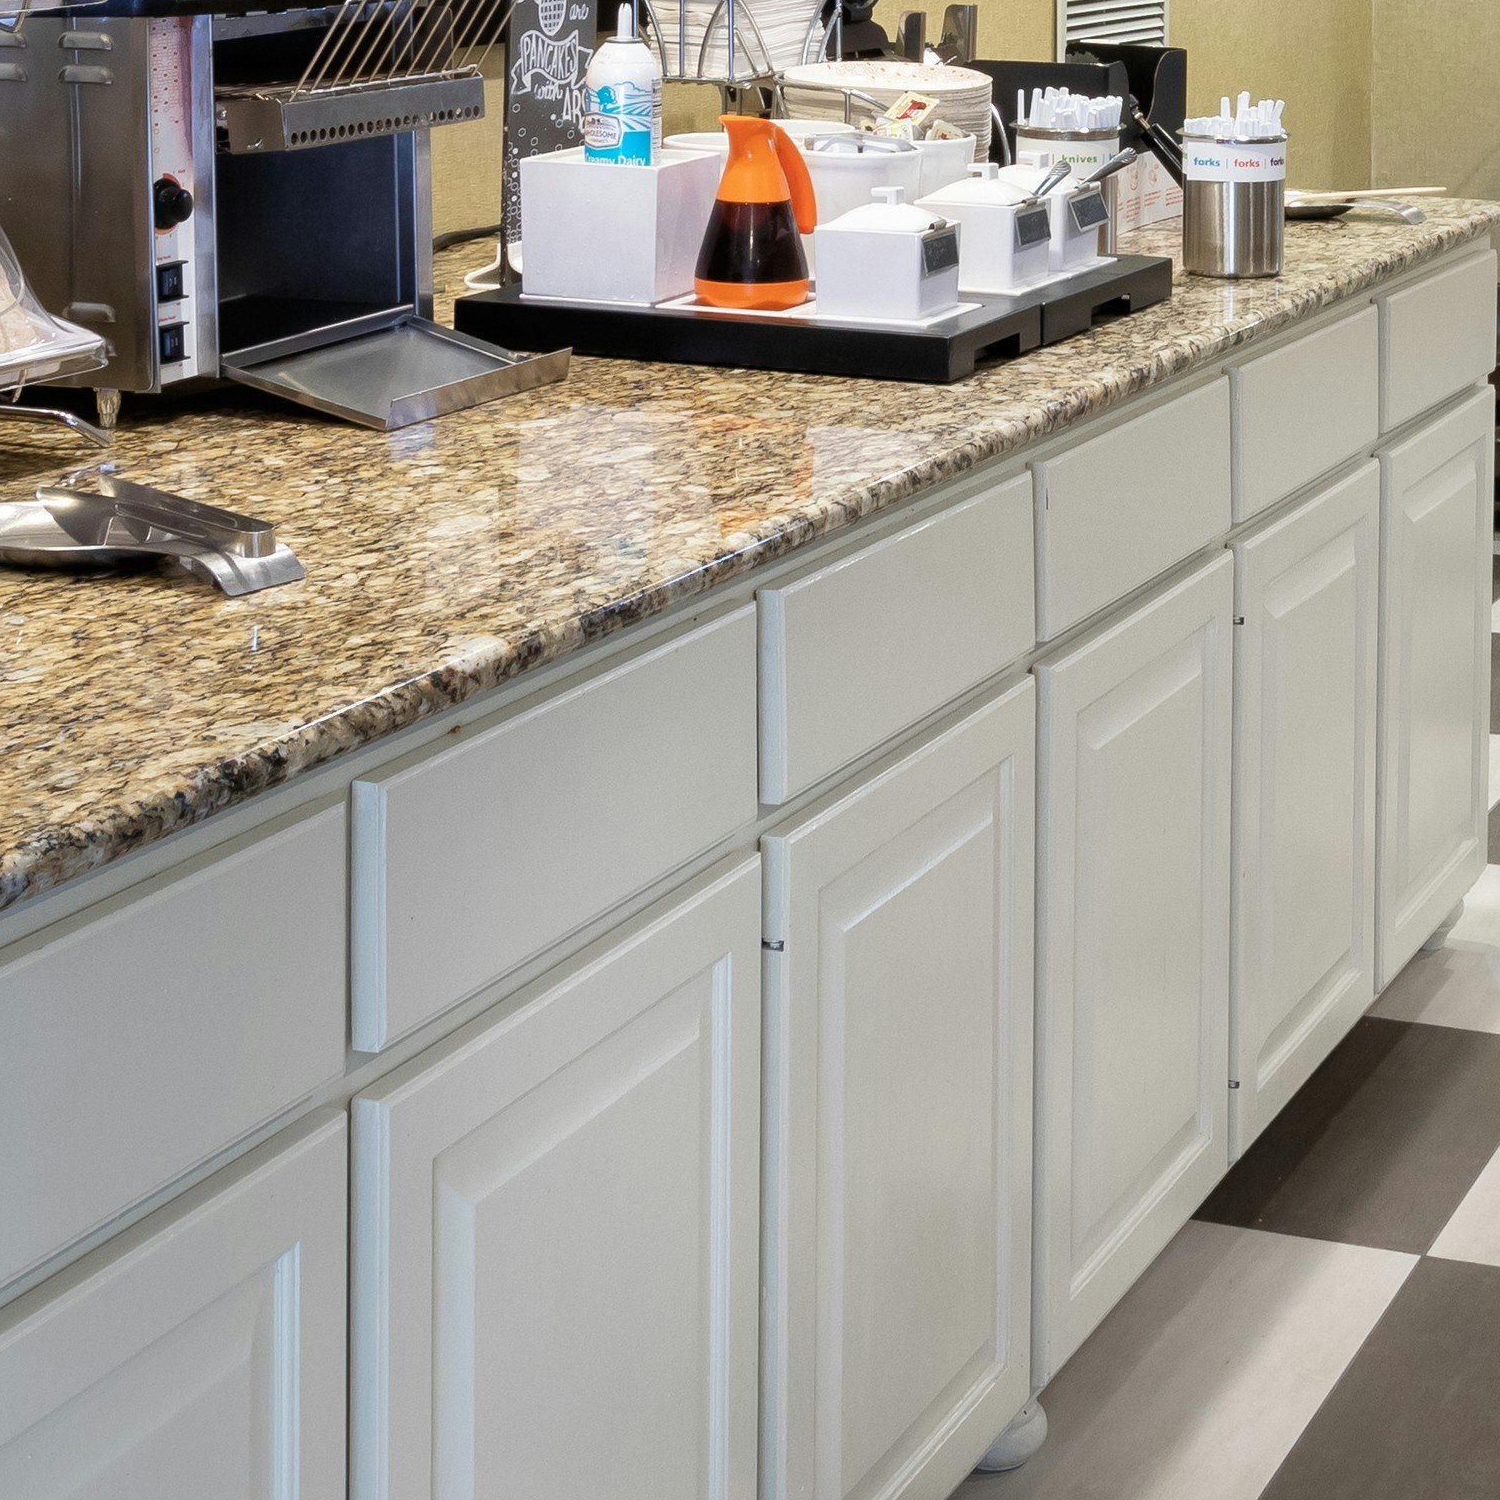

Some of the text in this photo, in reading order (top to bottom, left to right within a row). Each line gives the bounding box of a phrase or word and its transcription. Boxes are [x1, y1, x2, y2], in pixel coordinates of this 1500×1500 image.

[569, 4, 590, 20] are
[523, 33, 577, 79] PANCAKES
[534, 80, 563, 101] with
[1062, 154, 1097, 163] knives
[1194, 157, 1220, 166] forks
[1234, 158, 1260, 167] forks
